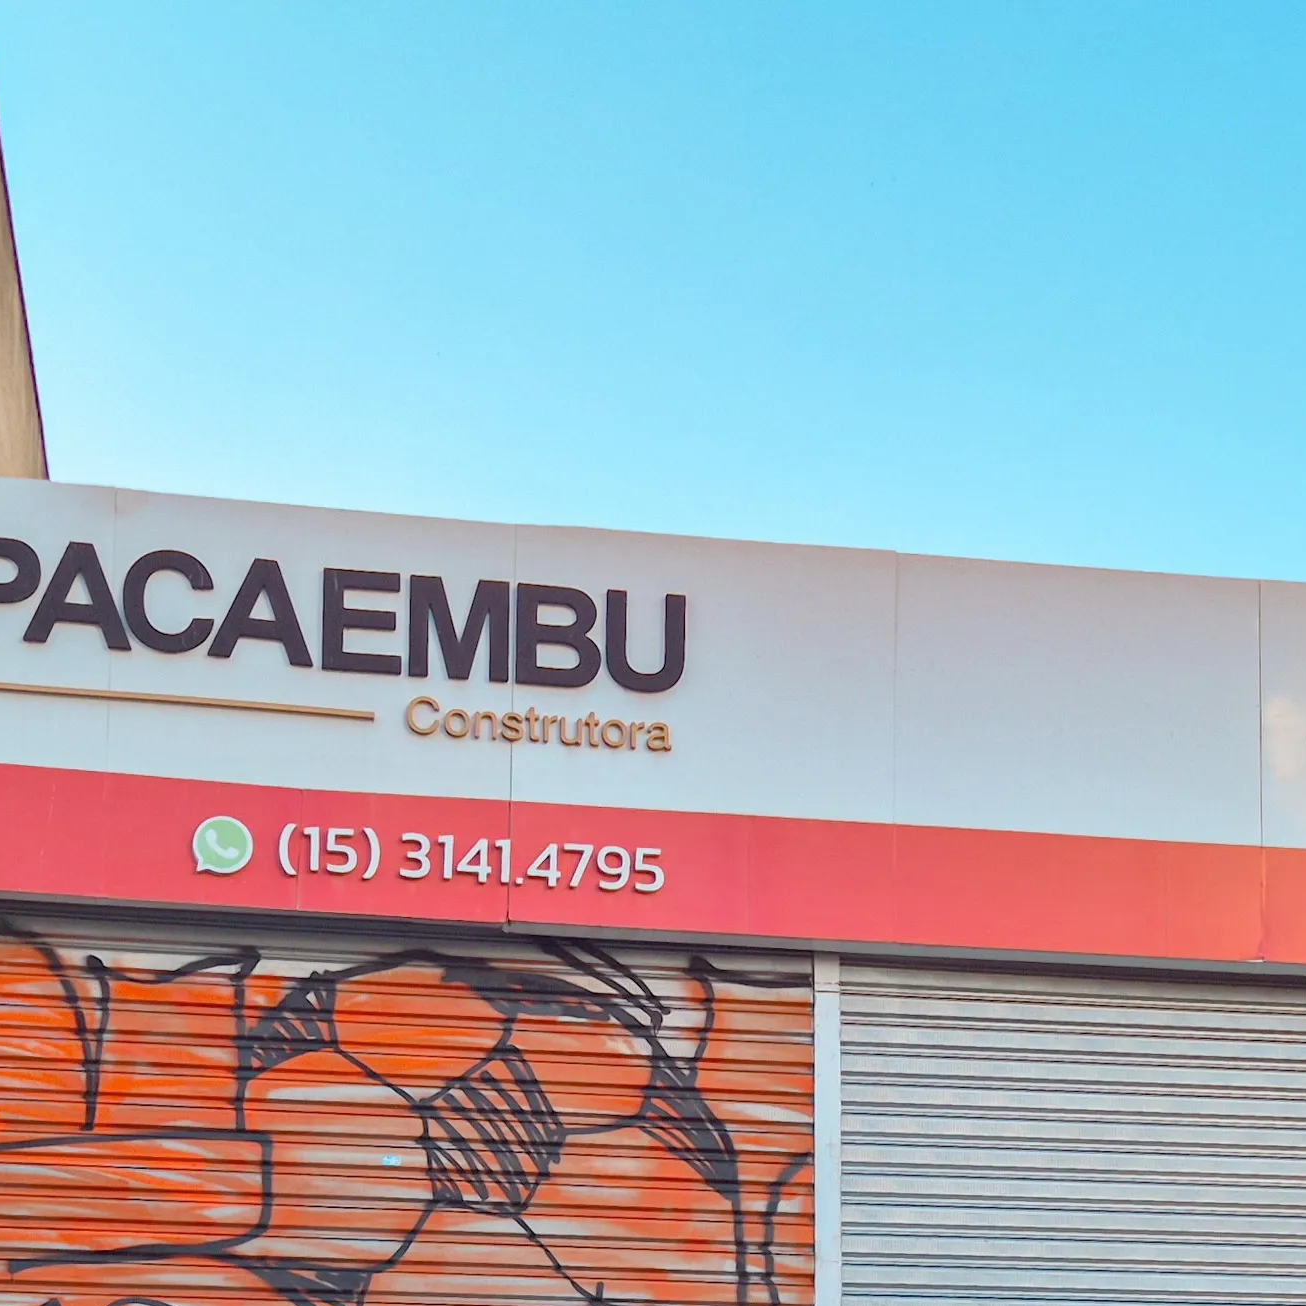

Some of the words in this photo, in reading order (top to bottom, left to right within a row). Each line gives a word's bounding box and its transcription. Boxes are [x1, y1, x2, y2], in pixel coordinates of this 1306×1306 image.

[405, 695, 673, 752] Construtora
[277, 823, 382, 880] (15)
[398, 832, 666, 892] 3141.4795
